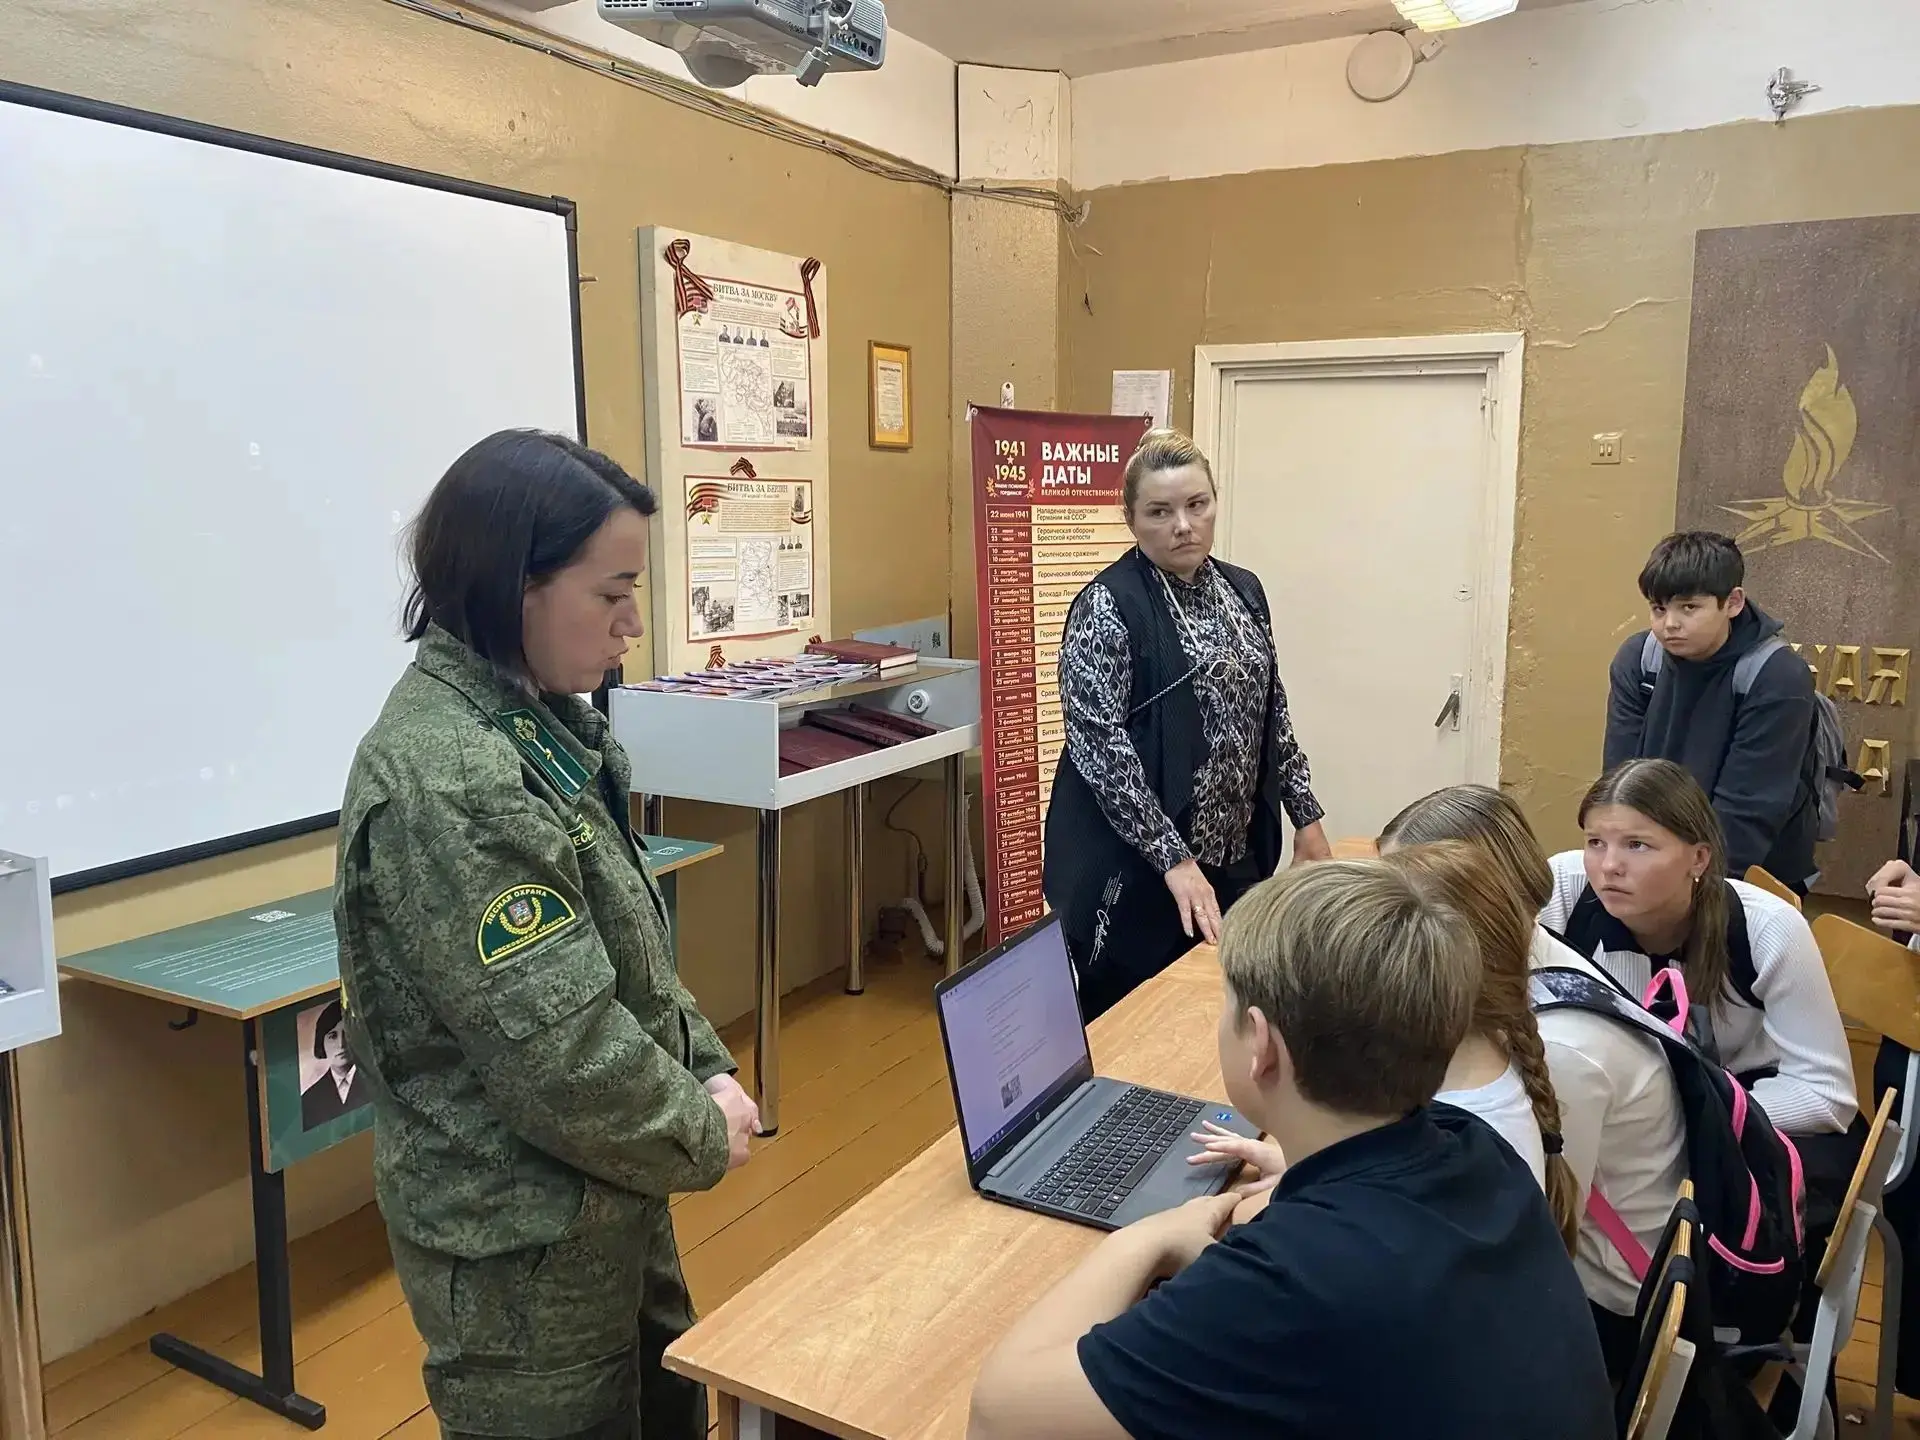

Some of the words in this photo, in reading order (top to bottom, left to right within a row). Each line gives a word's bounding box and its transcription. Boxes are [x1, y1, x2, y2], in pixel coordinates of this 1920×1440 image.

[714, 284, 739, 296] БИТВА
[741, 288, 750, 297] ЗА
[752, 290, 778, 302] МОСКВУ
[995, 440, 1025, 456] 1941
[1042, 442, 1119, 463] ВАЖНЫЕ
[995, 464, 1026, 481] 1945
[1042, 465, 1091, 488] ДАТЫ
[728, 483, 754, 492] БИТВА
[756, 484, 765, 492] ЗА
[1041, 488, 1070, 496] ВЕЛИКОЙ
[1071, 489, 1118, 497] ОТЕЧЕСТВЕННОЙ
[486, 894, 513, 925] ЛЕСНАЯ
[514, 888, 546, 897] ОХРАНА
[1004, 916, 1008, 925] 8
[1010, 914, 1022, 922] мая
[1025, 908, 1040, 918] 1945
